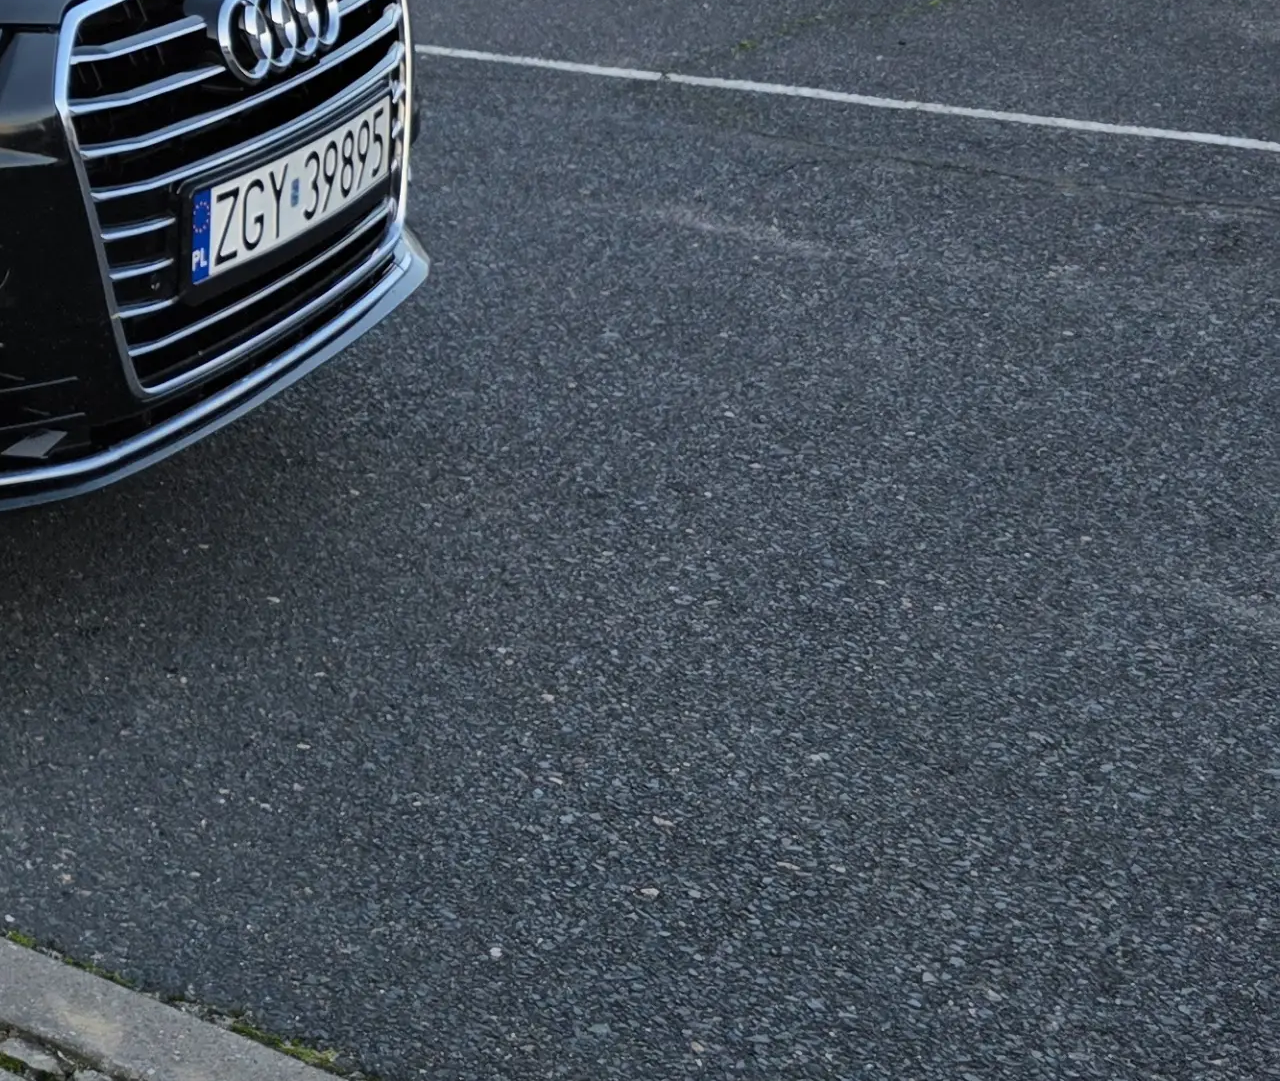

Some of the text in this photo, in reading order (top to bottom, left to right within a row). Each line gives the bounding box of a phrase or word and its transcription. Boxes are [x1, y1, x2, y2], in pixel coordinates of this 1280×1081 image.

[214, 106, 384, 267] ZGY 39895
[191, 247, 208, 271] PL
